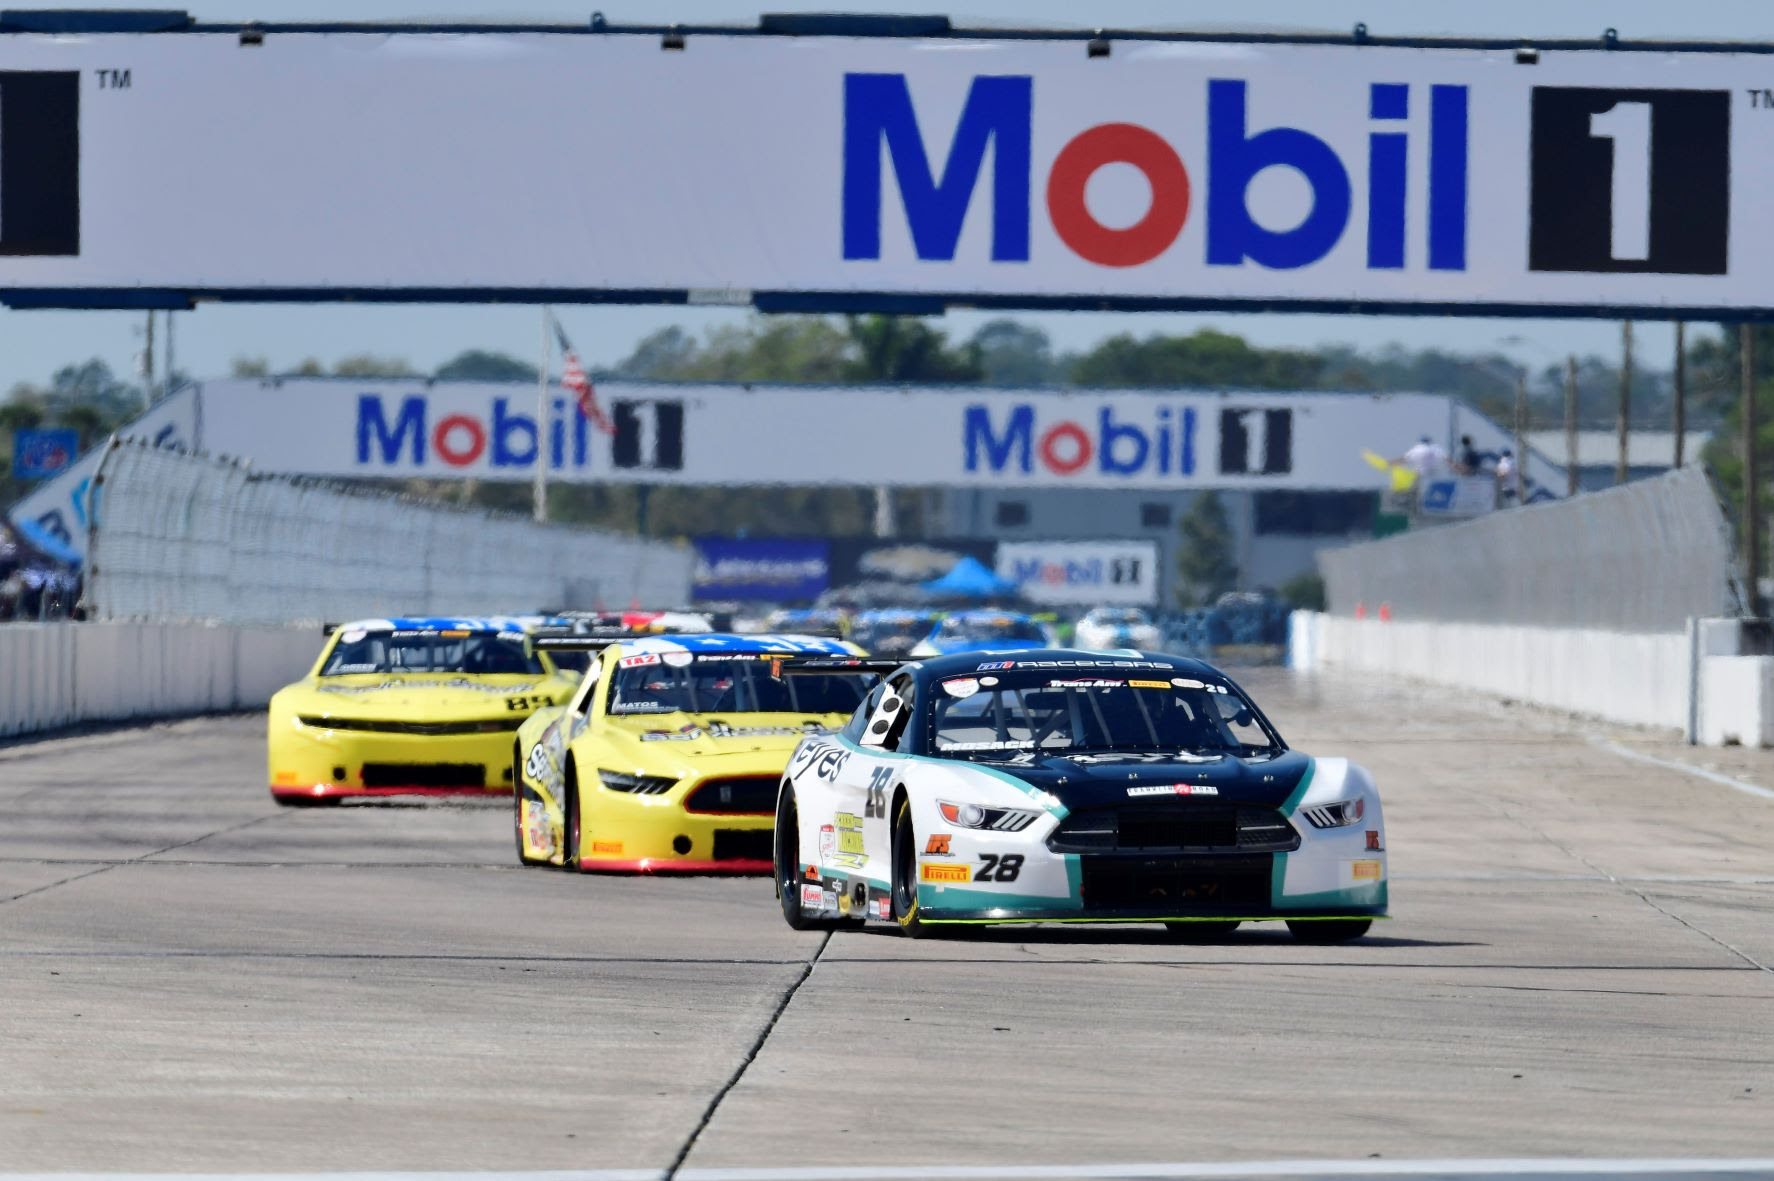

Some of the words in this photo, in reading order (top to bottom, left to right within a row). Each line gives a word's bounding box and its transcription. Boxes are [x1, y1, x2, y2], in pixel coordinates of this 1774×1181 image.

[95, 69, 132, 89] TM
[842, 72, 1470, 271] Mobil
[1588, 100, 1653, 261] 1
[356, 395, 588, 468] Mobil
[963, 402, 1198, 476] Mobil
[624, 655, 656, 667] TA2
[1050, 680, 1092, 688] Trans
[1094, 679, 1123, 687] Am
[1205, 683, 1228, 695] 28
[617, 701, 659, 709] MATOS
[940, 740, 1036, 751] MOSACK
[924, 865, 968, 880] PIRELLI
[973, 853, 1025, 882] 28
